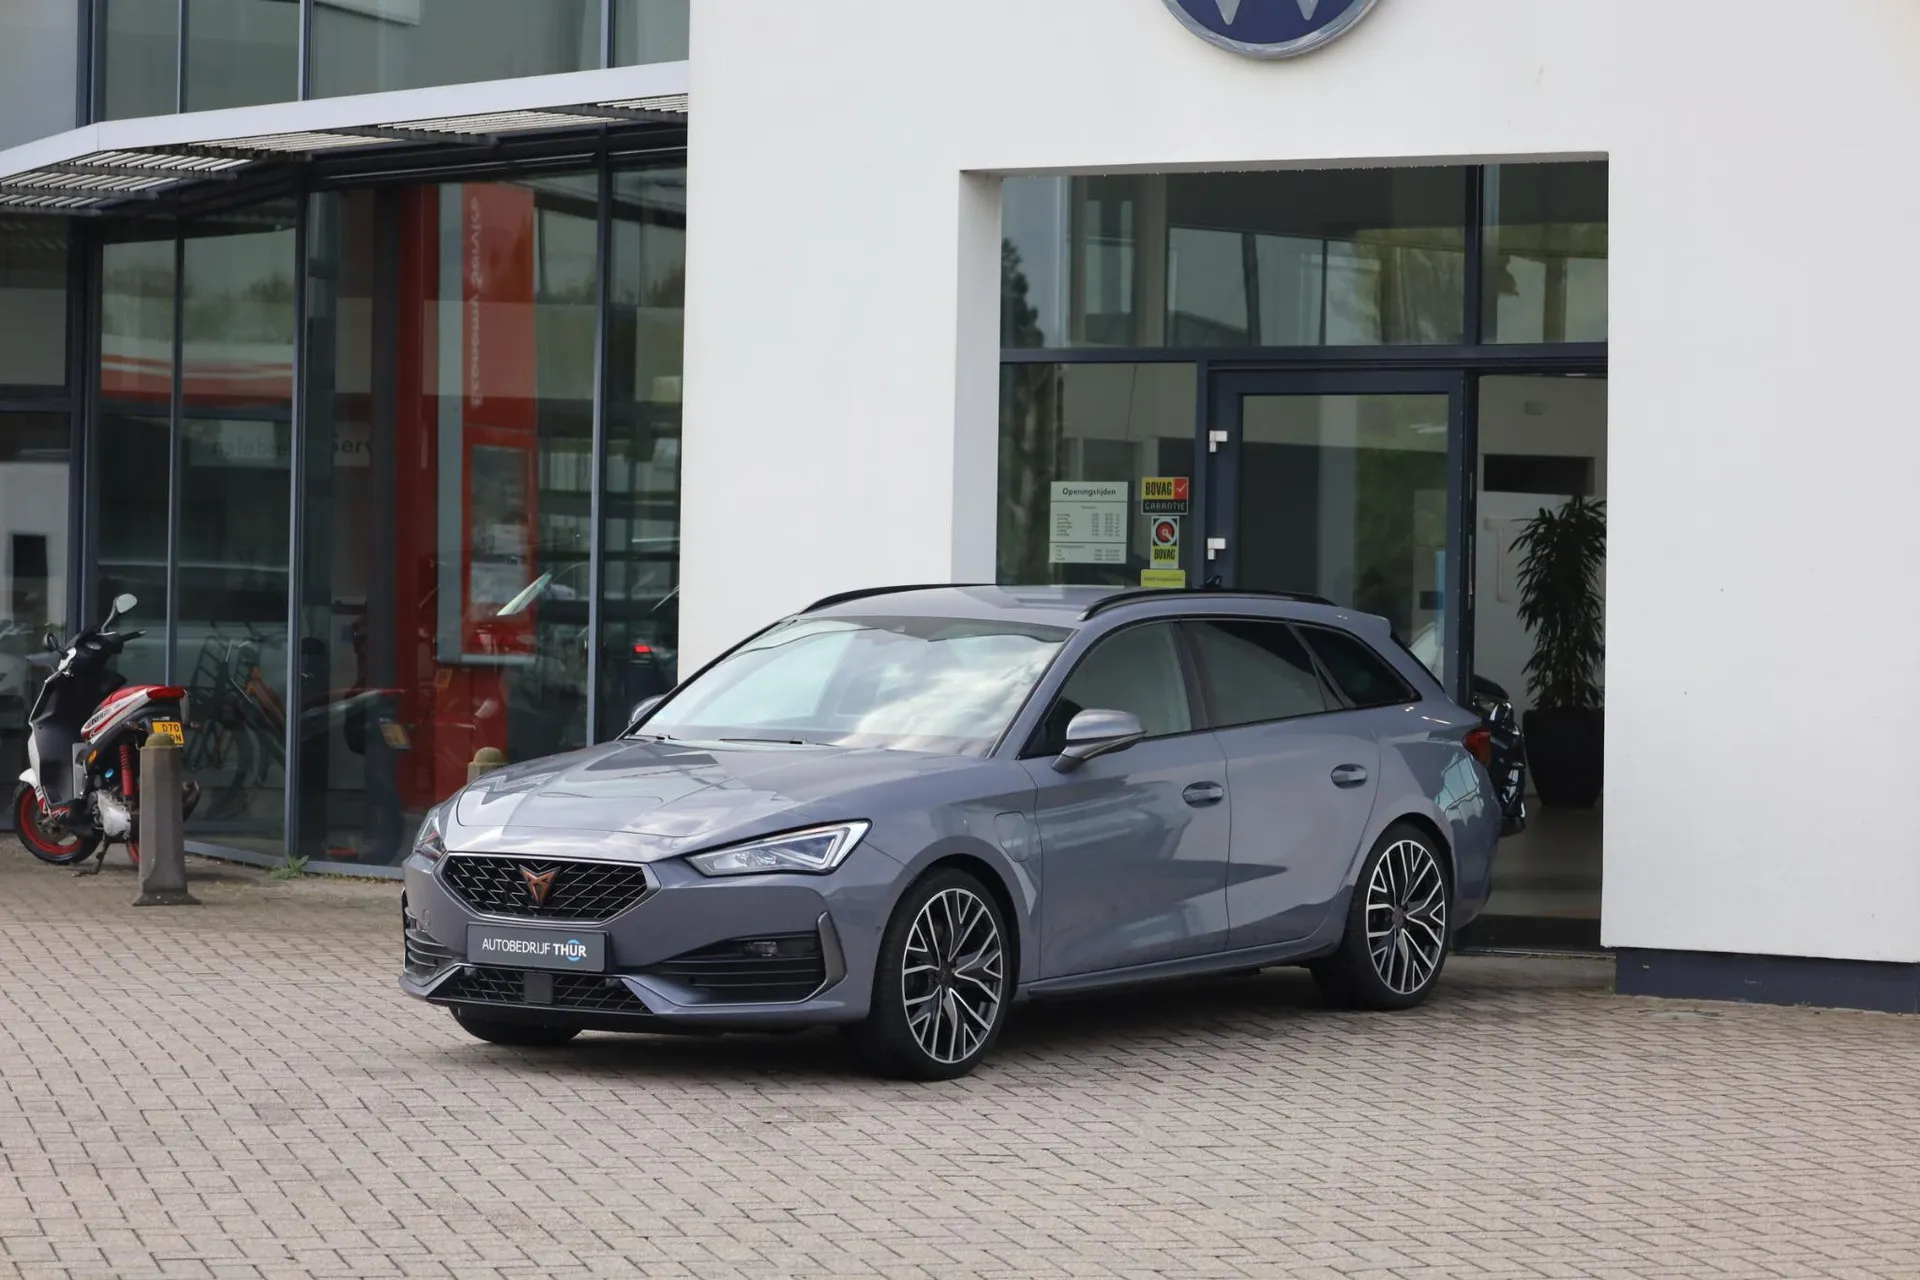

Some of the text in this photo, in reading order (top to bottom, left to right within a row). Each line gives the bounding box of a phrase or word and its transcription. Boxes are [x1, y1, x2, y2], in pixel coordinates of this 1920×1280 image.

[1062, 487, 1117, 498] Openingstijden
[1145, 481, 1172, 496] BOVAG
[1144, 501, 1186, 511] GARANTIE
[1154, 548, 1176, 560] BOVAG
[482, 938, 551, 955] AUTOBEDRIJF
